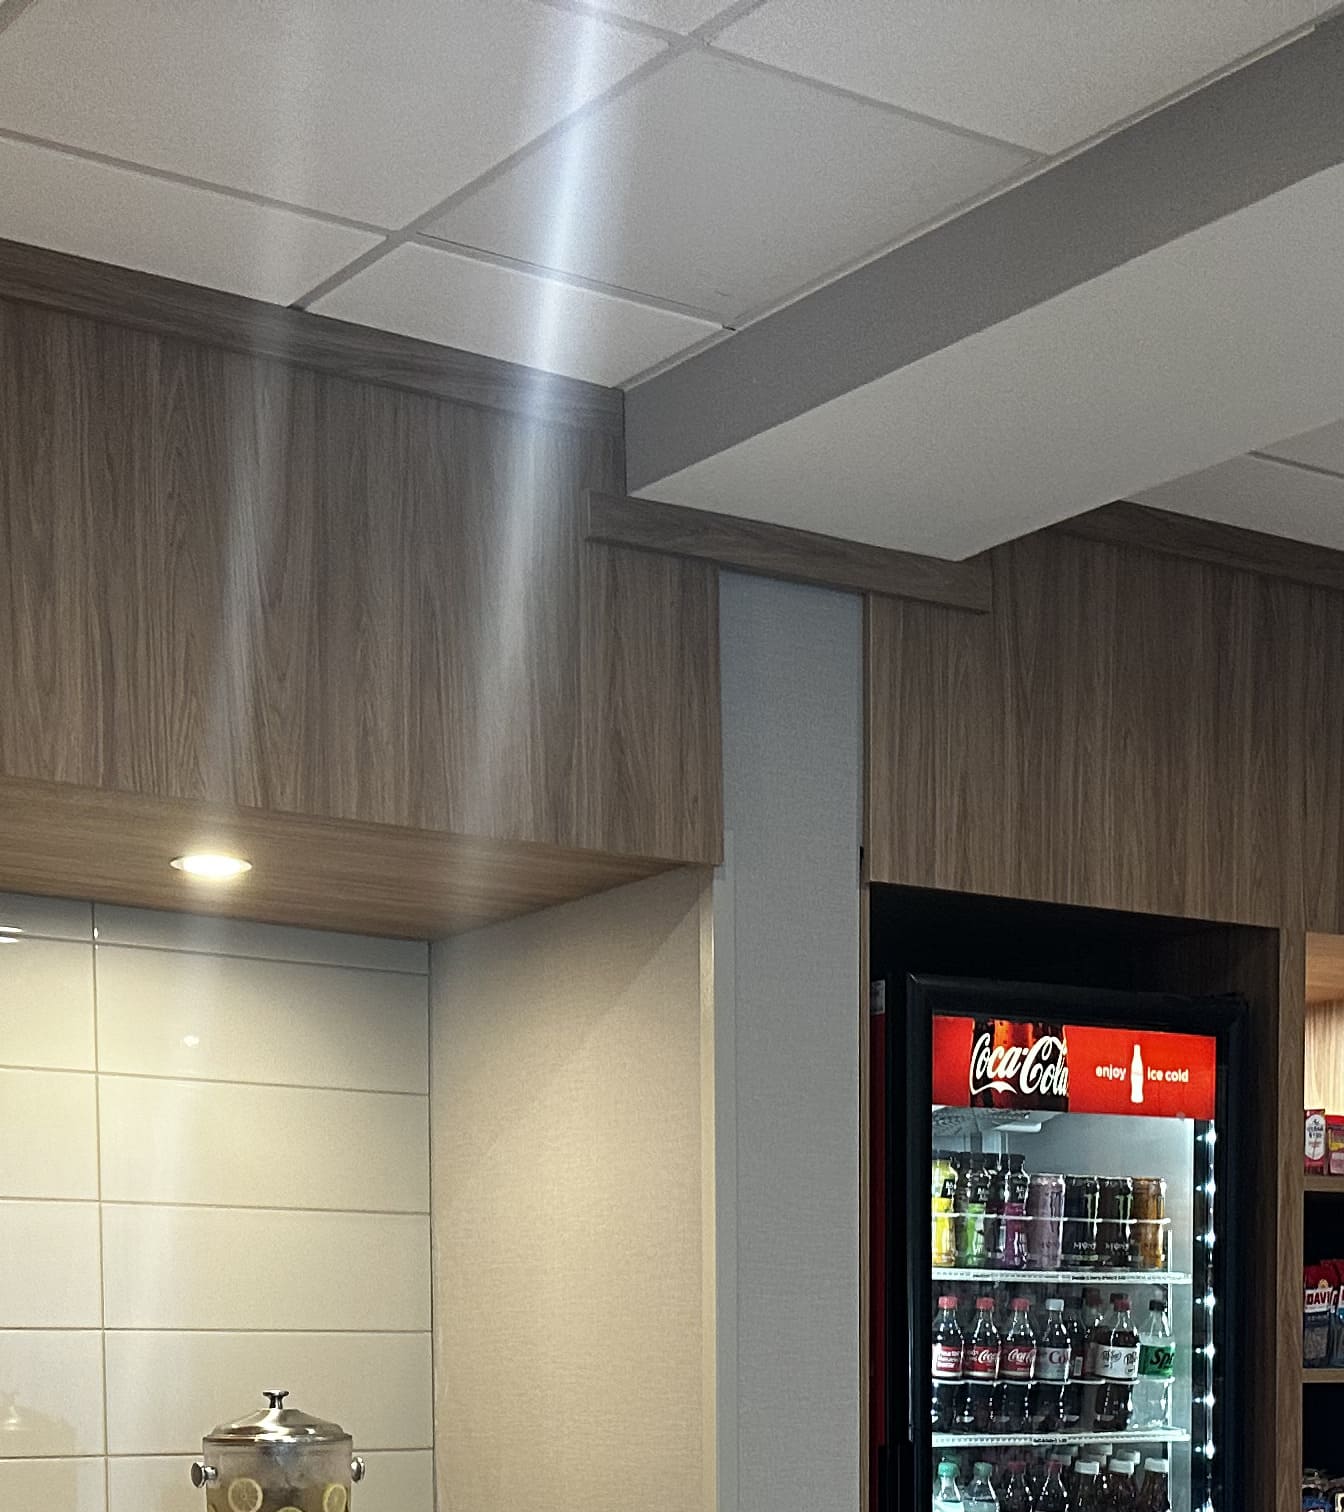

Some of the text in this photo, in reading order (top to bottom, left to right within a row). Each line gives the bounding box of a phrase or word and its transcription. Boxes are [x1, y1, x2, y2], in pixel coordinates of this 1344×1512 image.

[970, 1032, 1068, 1096] Coca-Cola
[1095, 1066, 1189, 1083] enjoy ice cold
[1306, 1291, 1330, 1305] DAVI
